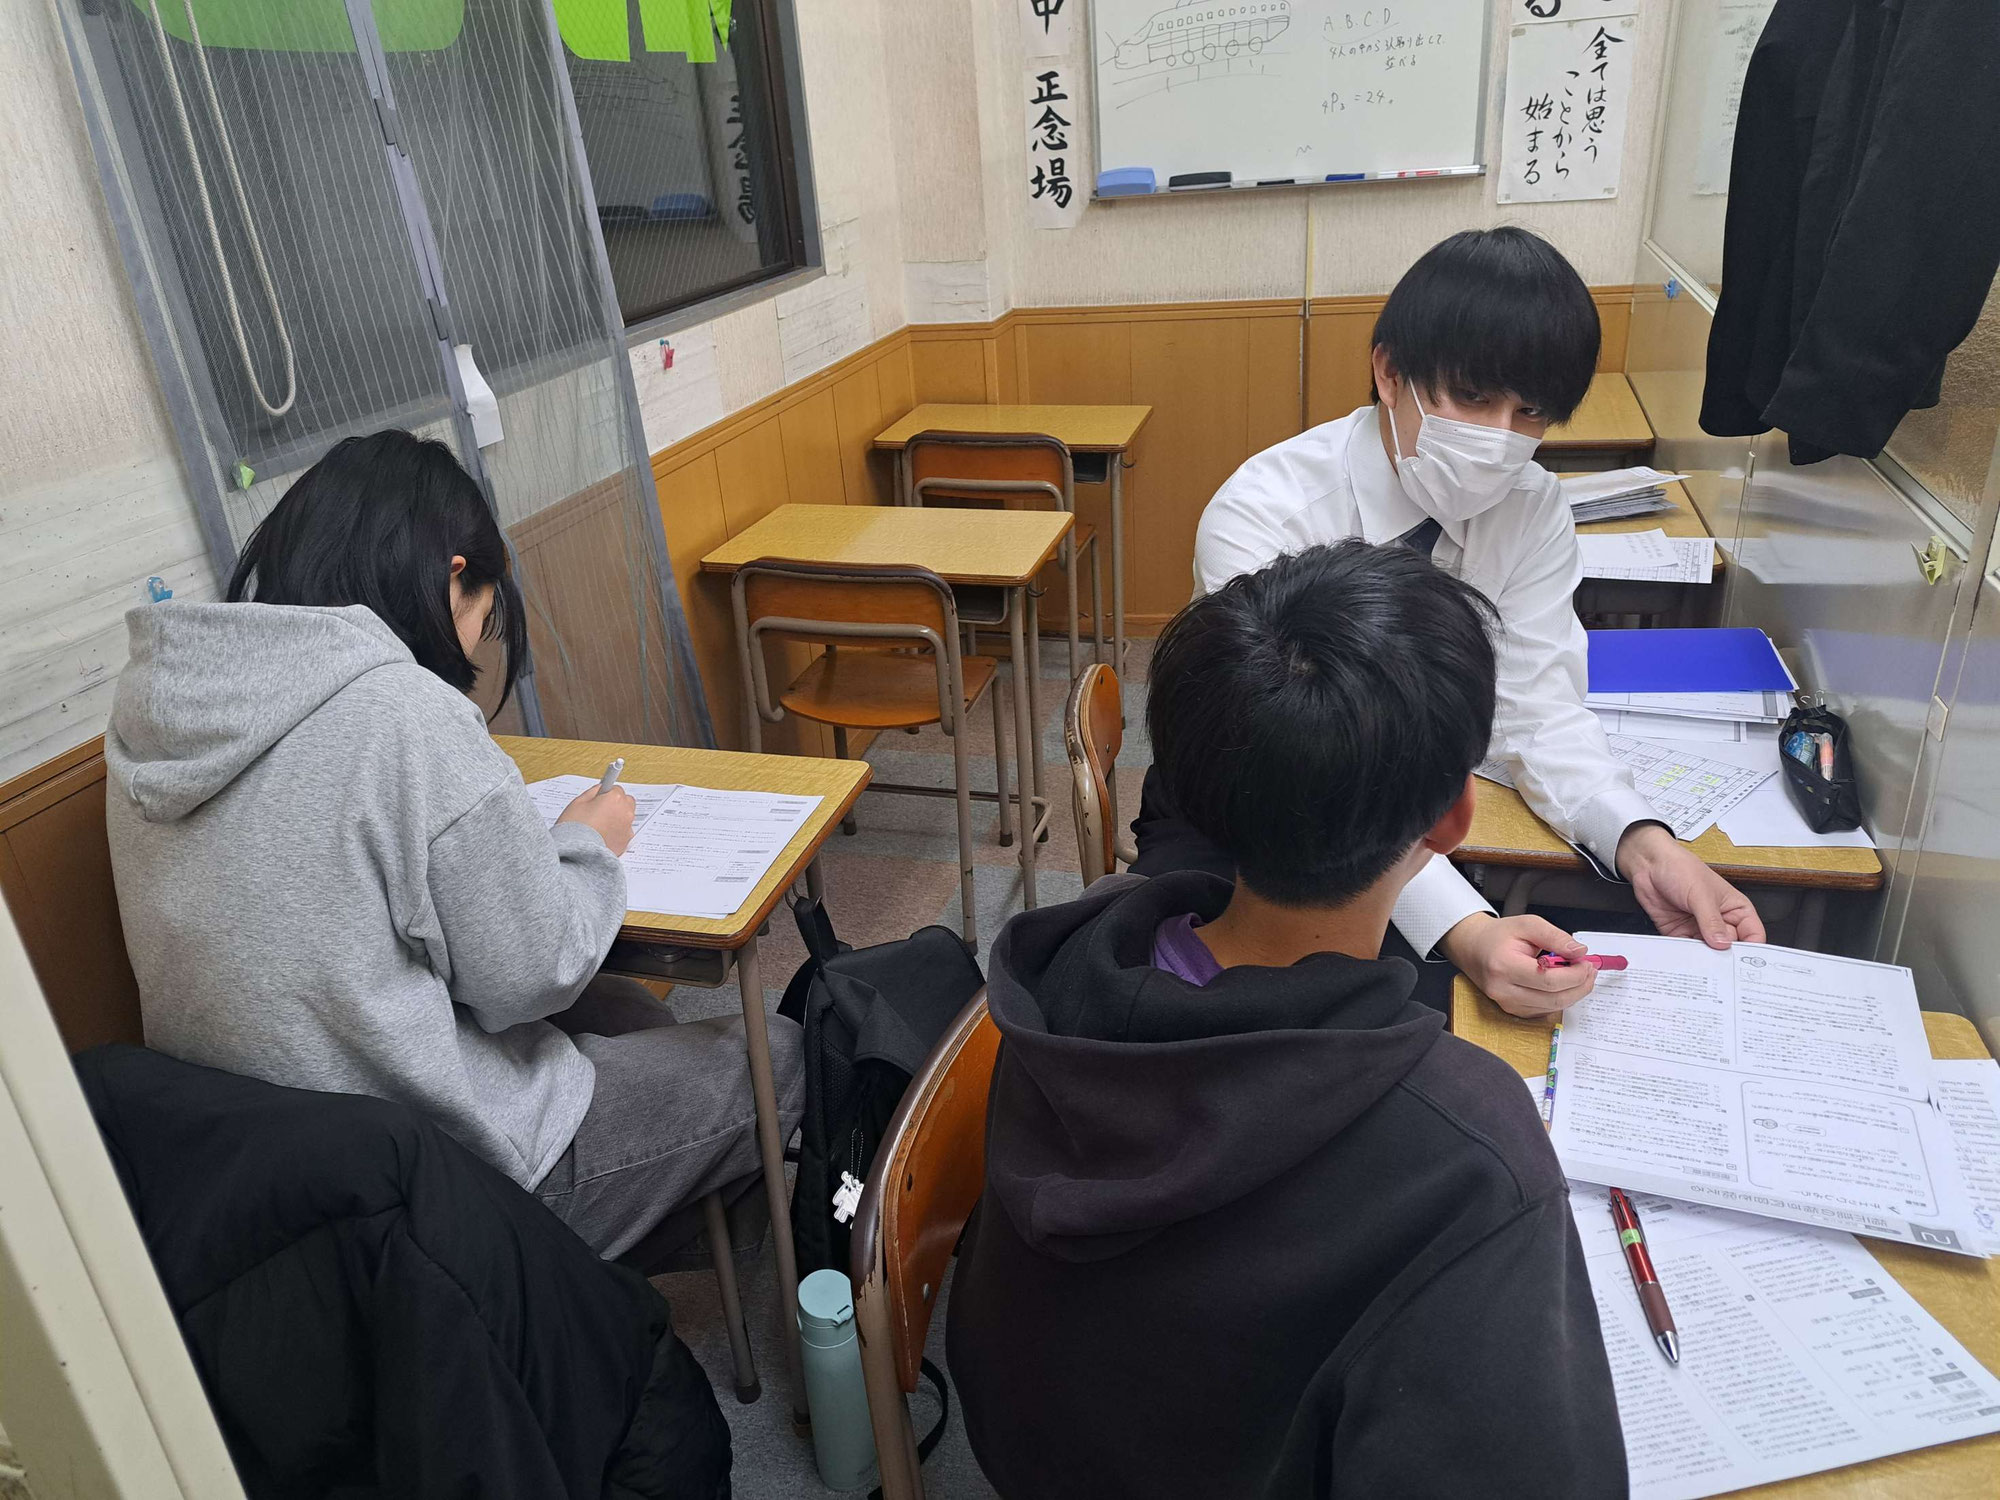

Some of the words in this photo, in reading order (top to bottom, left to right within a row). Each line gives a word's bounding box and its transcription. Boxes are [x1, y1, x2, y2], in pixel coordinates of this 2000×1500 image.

[1030, 71, 1073, 209] 正念場
[1520, 93, 1554, 185] 始まる
[1552, 70, 1580, 180] ことから
[1582, 26, 1626, 164] 全ては思う
